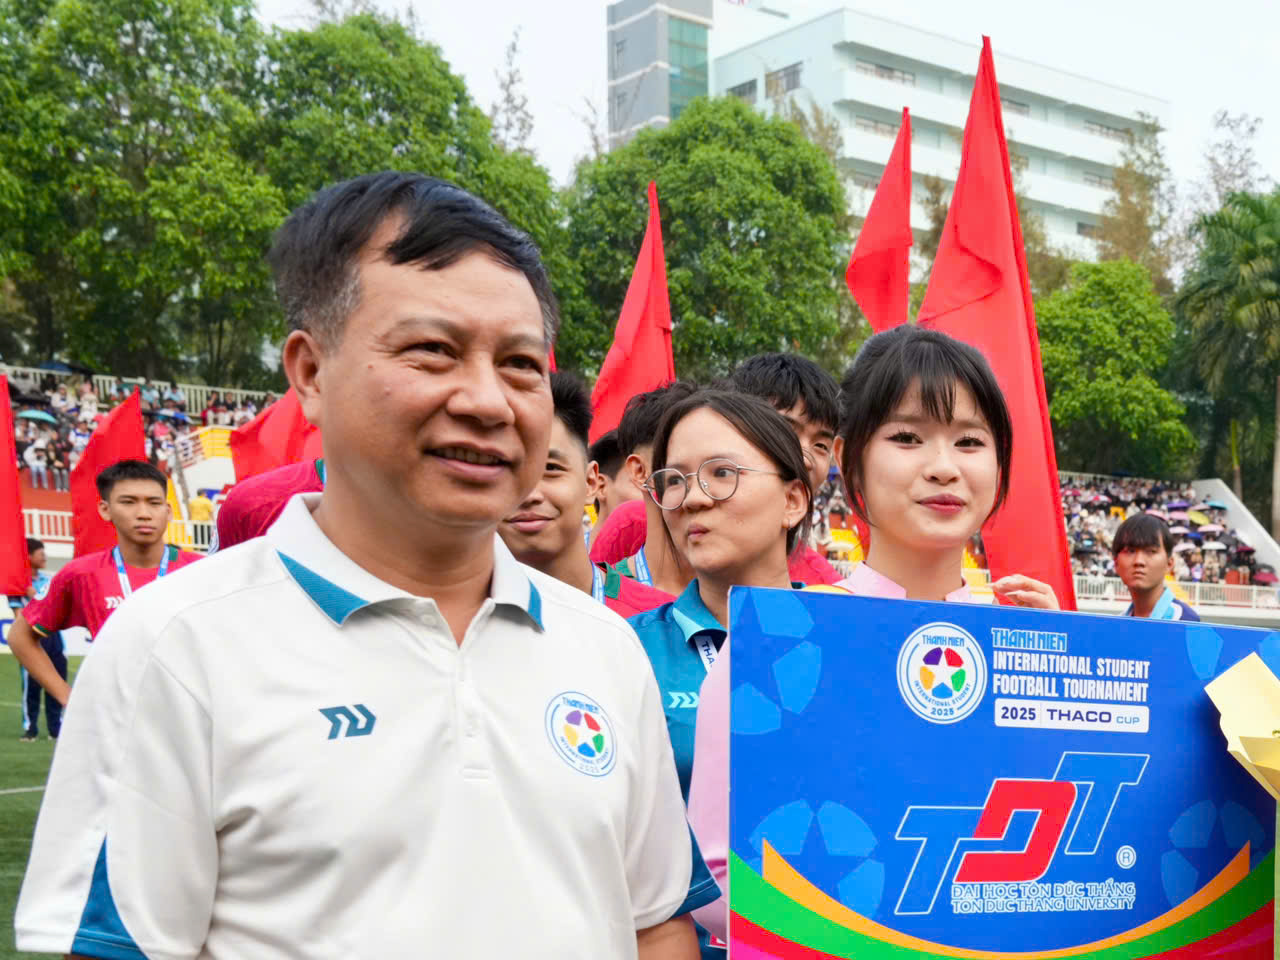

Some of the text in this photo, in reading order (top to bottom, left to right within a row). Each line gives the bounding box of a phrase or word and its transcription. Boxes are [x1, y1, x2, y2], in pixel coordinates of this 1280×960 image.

[701, 640, 716, 667] THA
[992, 651, 1150, 679] INTERNATIONAL STUDENT
[914, 680, 971, 707] INTERNATIONAL STUDENT
[992, 673, 1149, 702] FOOTBALL TOURNAMENT
[930, 707, 954, 716] 2025
[1001, 706, 1140, 725] 2025 THACO CUP
[952, 895, 1137, 914] TON DUC THANG UNIVERSITY
